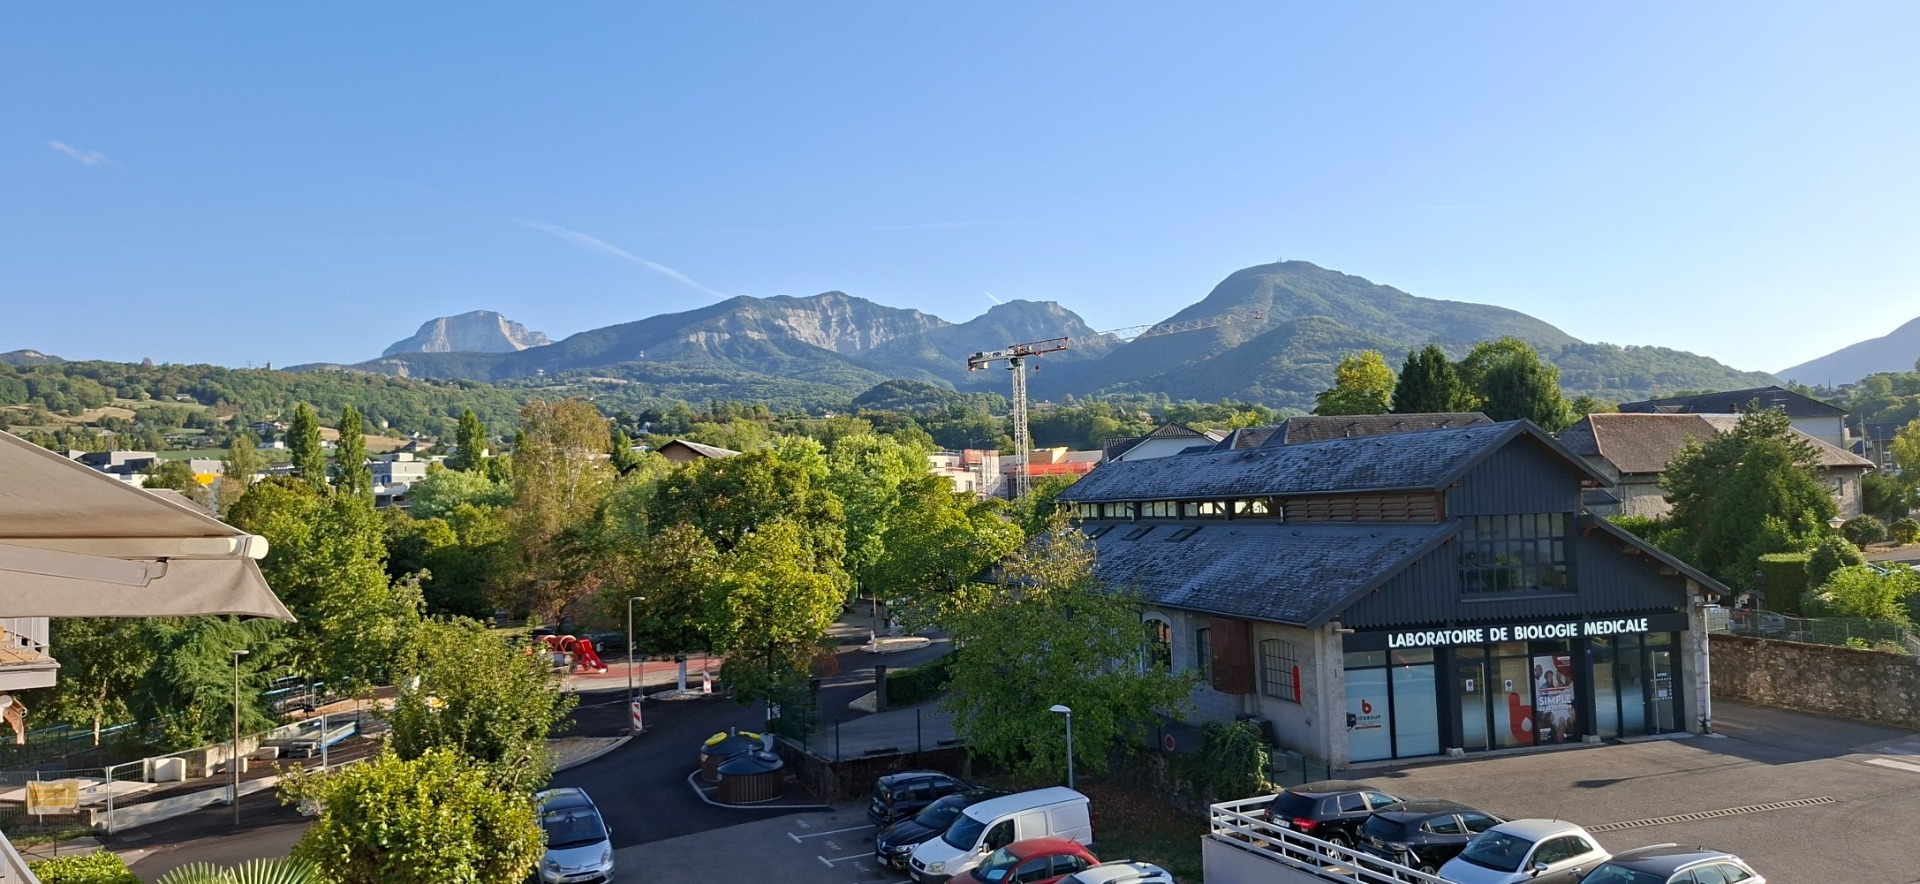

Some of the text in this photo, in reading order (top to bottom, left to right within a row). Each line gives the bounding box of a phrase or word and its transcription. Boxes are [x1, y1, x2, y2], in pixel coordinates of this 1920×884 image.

[1388, 618, 1648, 648] LABORATOIRE DE BIOLOGIE MEDICALE
[1538, 694, 1573, 706] SIMPLE
